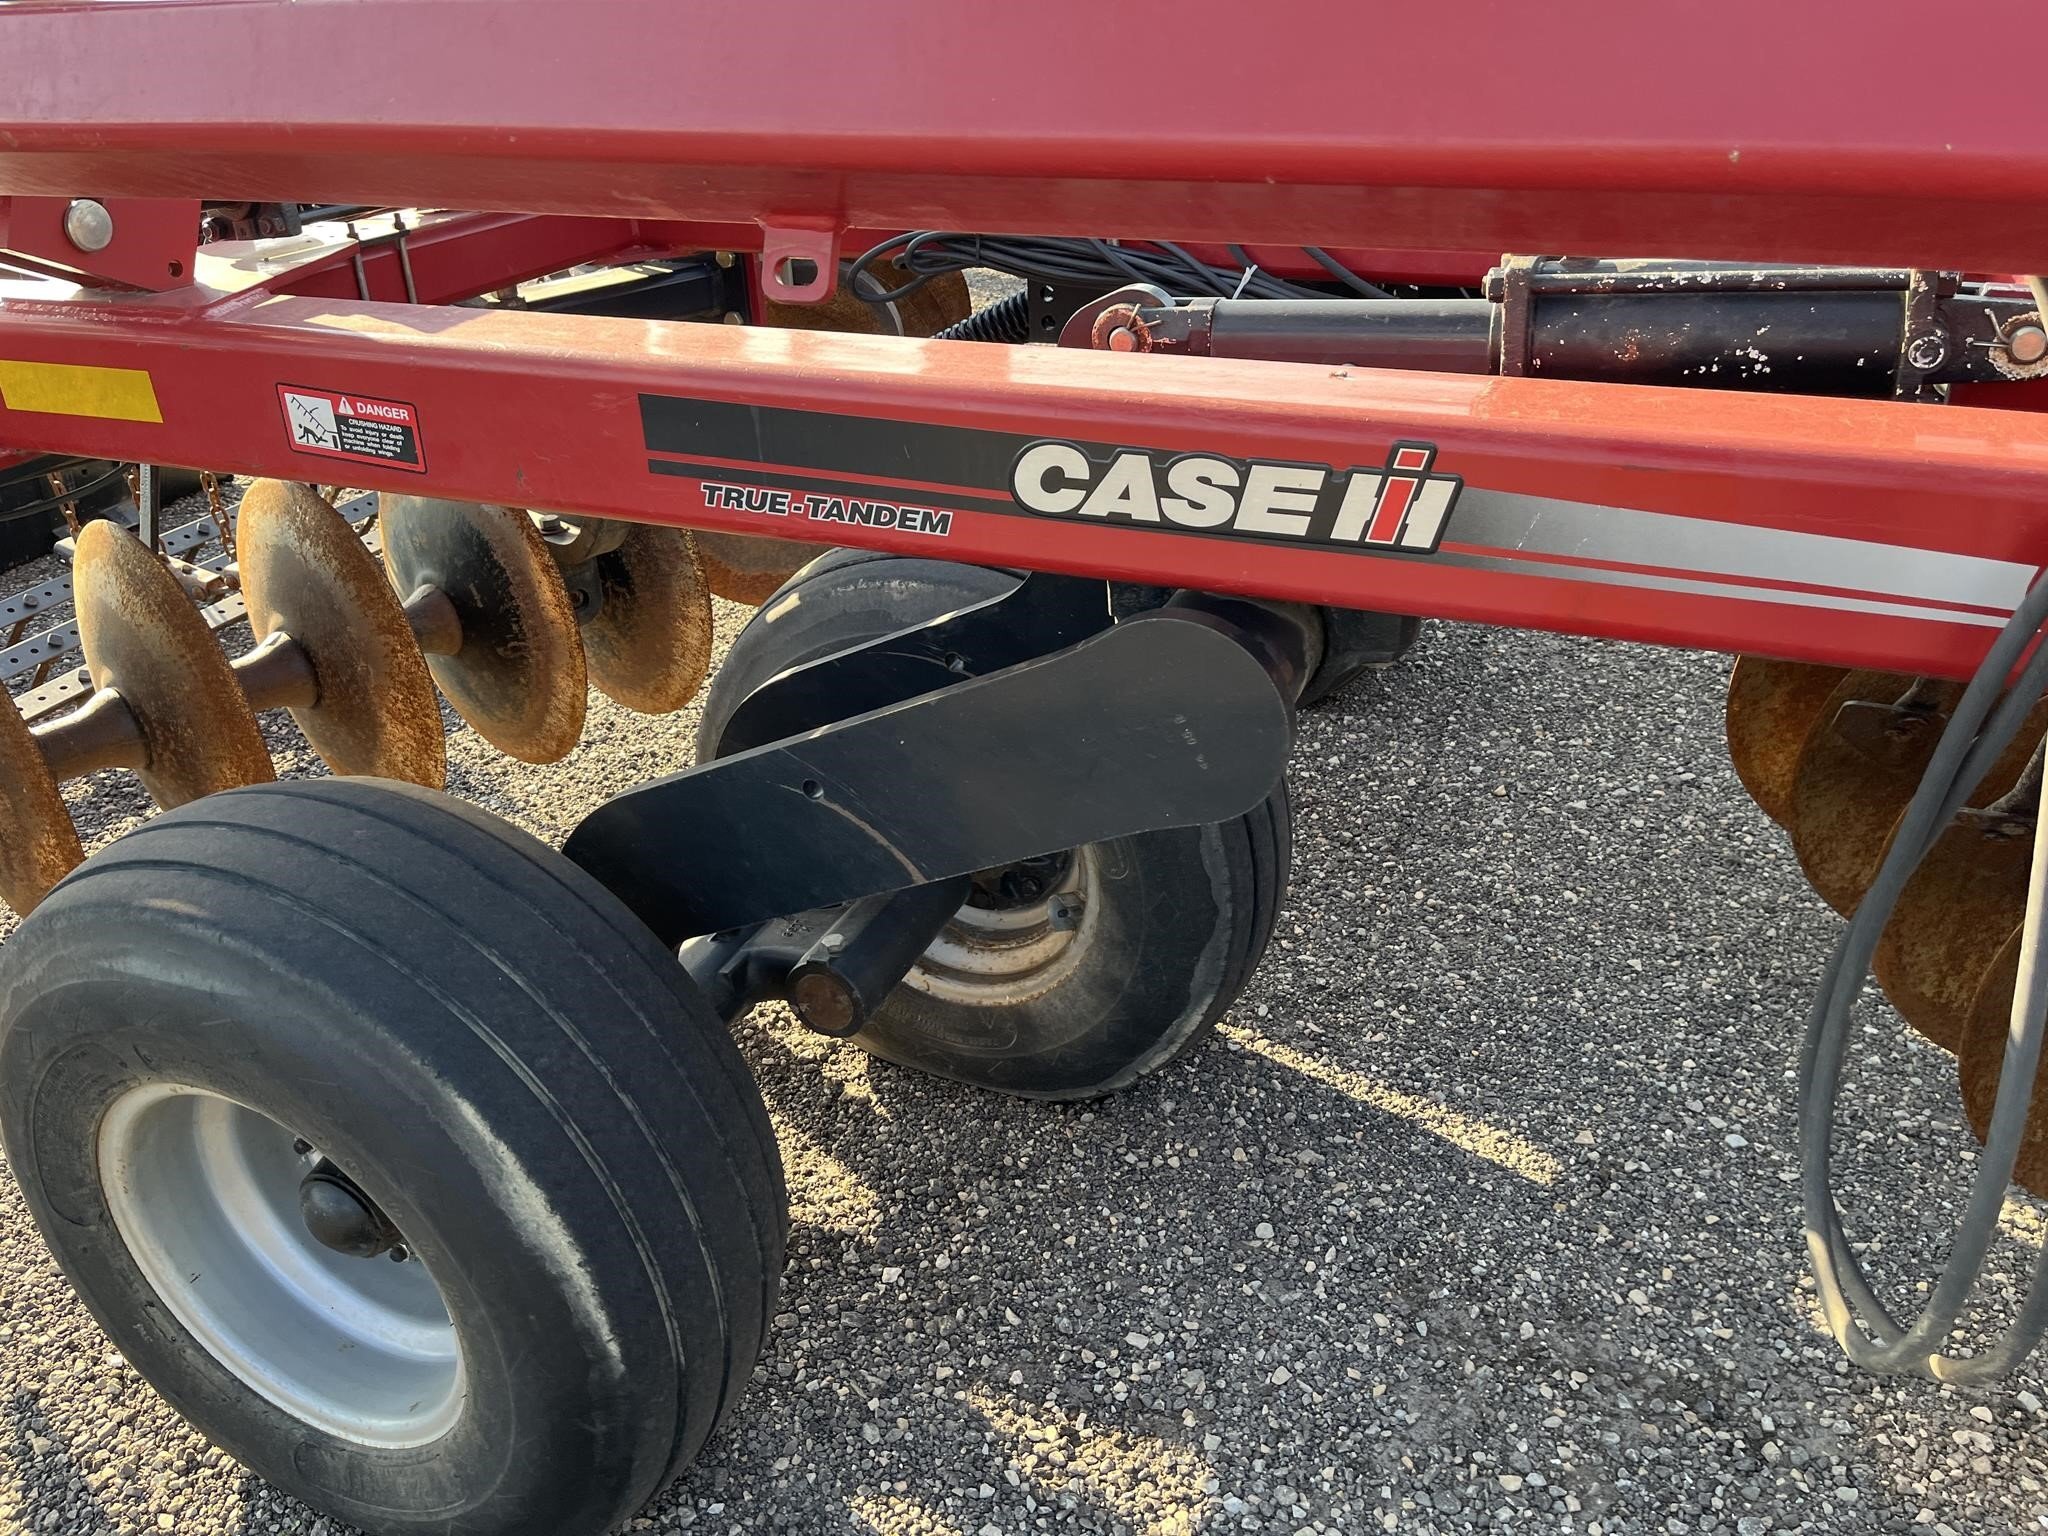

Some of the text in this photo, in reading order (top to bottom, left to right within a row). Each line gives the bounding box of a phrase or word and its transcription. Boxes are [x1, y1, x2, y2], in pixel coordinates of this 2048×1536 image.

[357, 402, 409, 420] DANGER
[349, 419, 402, 433] CRUSHING HAZARD
[365, 429, 379, 437] injury
[352, 445, 375, 454] unfolding
[383, 444, 400, 452] folding
[1013, 443, 1325, 537] CASE
[701, 482, 953, 537] TRUE-TANDEM
